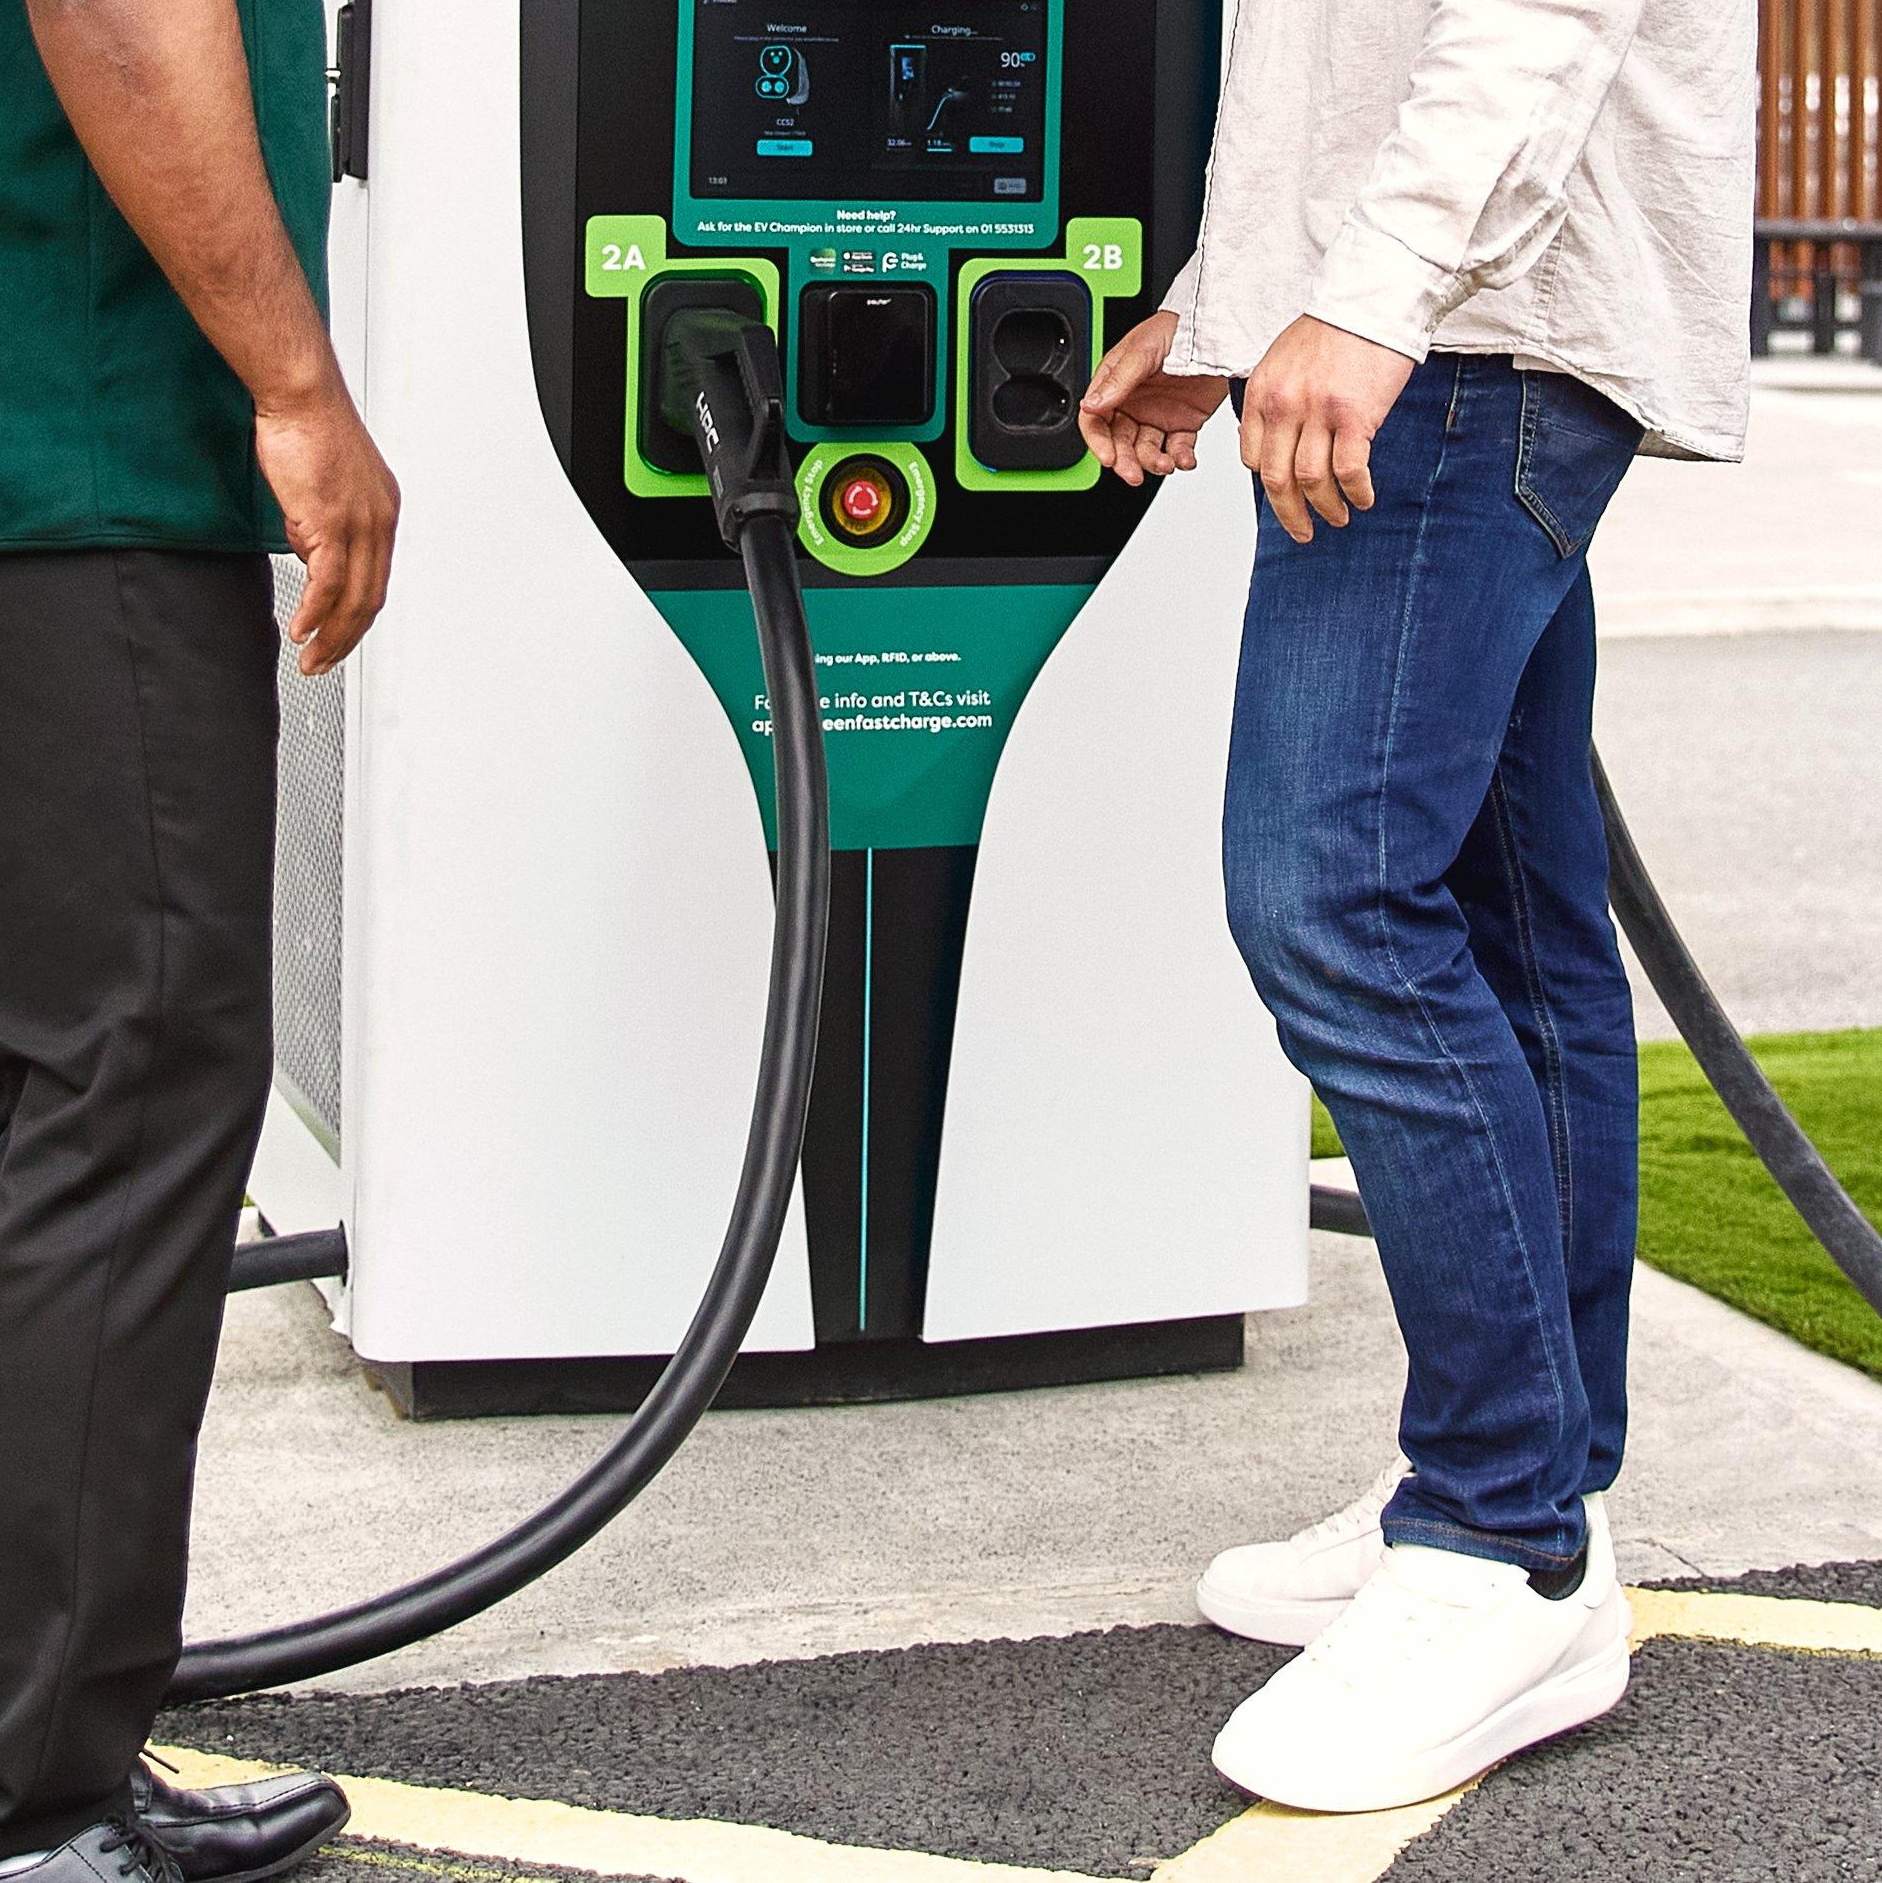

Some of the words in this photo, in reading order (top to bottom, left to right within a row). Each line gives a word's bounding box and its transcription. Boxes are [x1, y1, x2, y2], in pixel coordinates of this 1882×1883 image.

[766, 24, 808, 34] Welcome
[836, 209, 865, 220] Need
[866, 210, 897, 222] help?
[697, 221, 716, 232] Ask
[717, 221, 733, 232] for
[733, 222, 752, 232] the
[754, 222, 768, 232] EV
[769, 222, 823, 235] Champion
[824, 223, 835, 233] in
[836, 223, 863, 234] store
[864, 225, 876, 234] or
[877, 223, 896, 234] call
[897, 223, 922, 234] 24hr
[923, 224, 964, 235] Support
[965, 225, 979, 234] on
[980, 224, 993, 234] 01
[601, 244, 647, 272] 2A
[1082, 244, 1123, 271] 2B
[803, 459, 824, 485] Stop
[802, 485, 825, 546] Emergency
[814, 653, 834, 666] ing
[835, 655, 854, 664] our
[855, 653, 880, 666] App,
[881, 652, 910, 664] RFID,
[911, 654, 924, 663] or
[924, 652, 961, 662] above.
[834, 692, 868, 709] info
[871, 691, 905, 708] and
[908, 690, 954, 707] T&Cs
[956, 689, 991, 706] visit
[751, 713, 993, 736] apeenfastcharge.com
